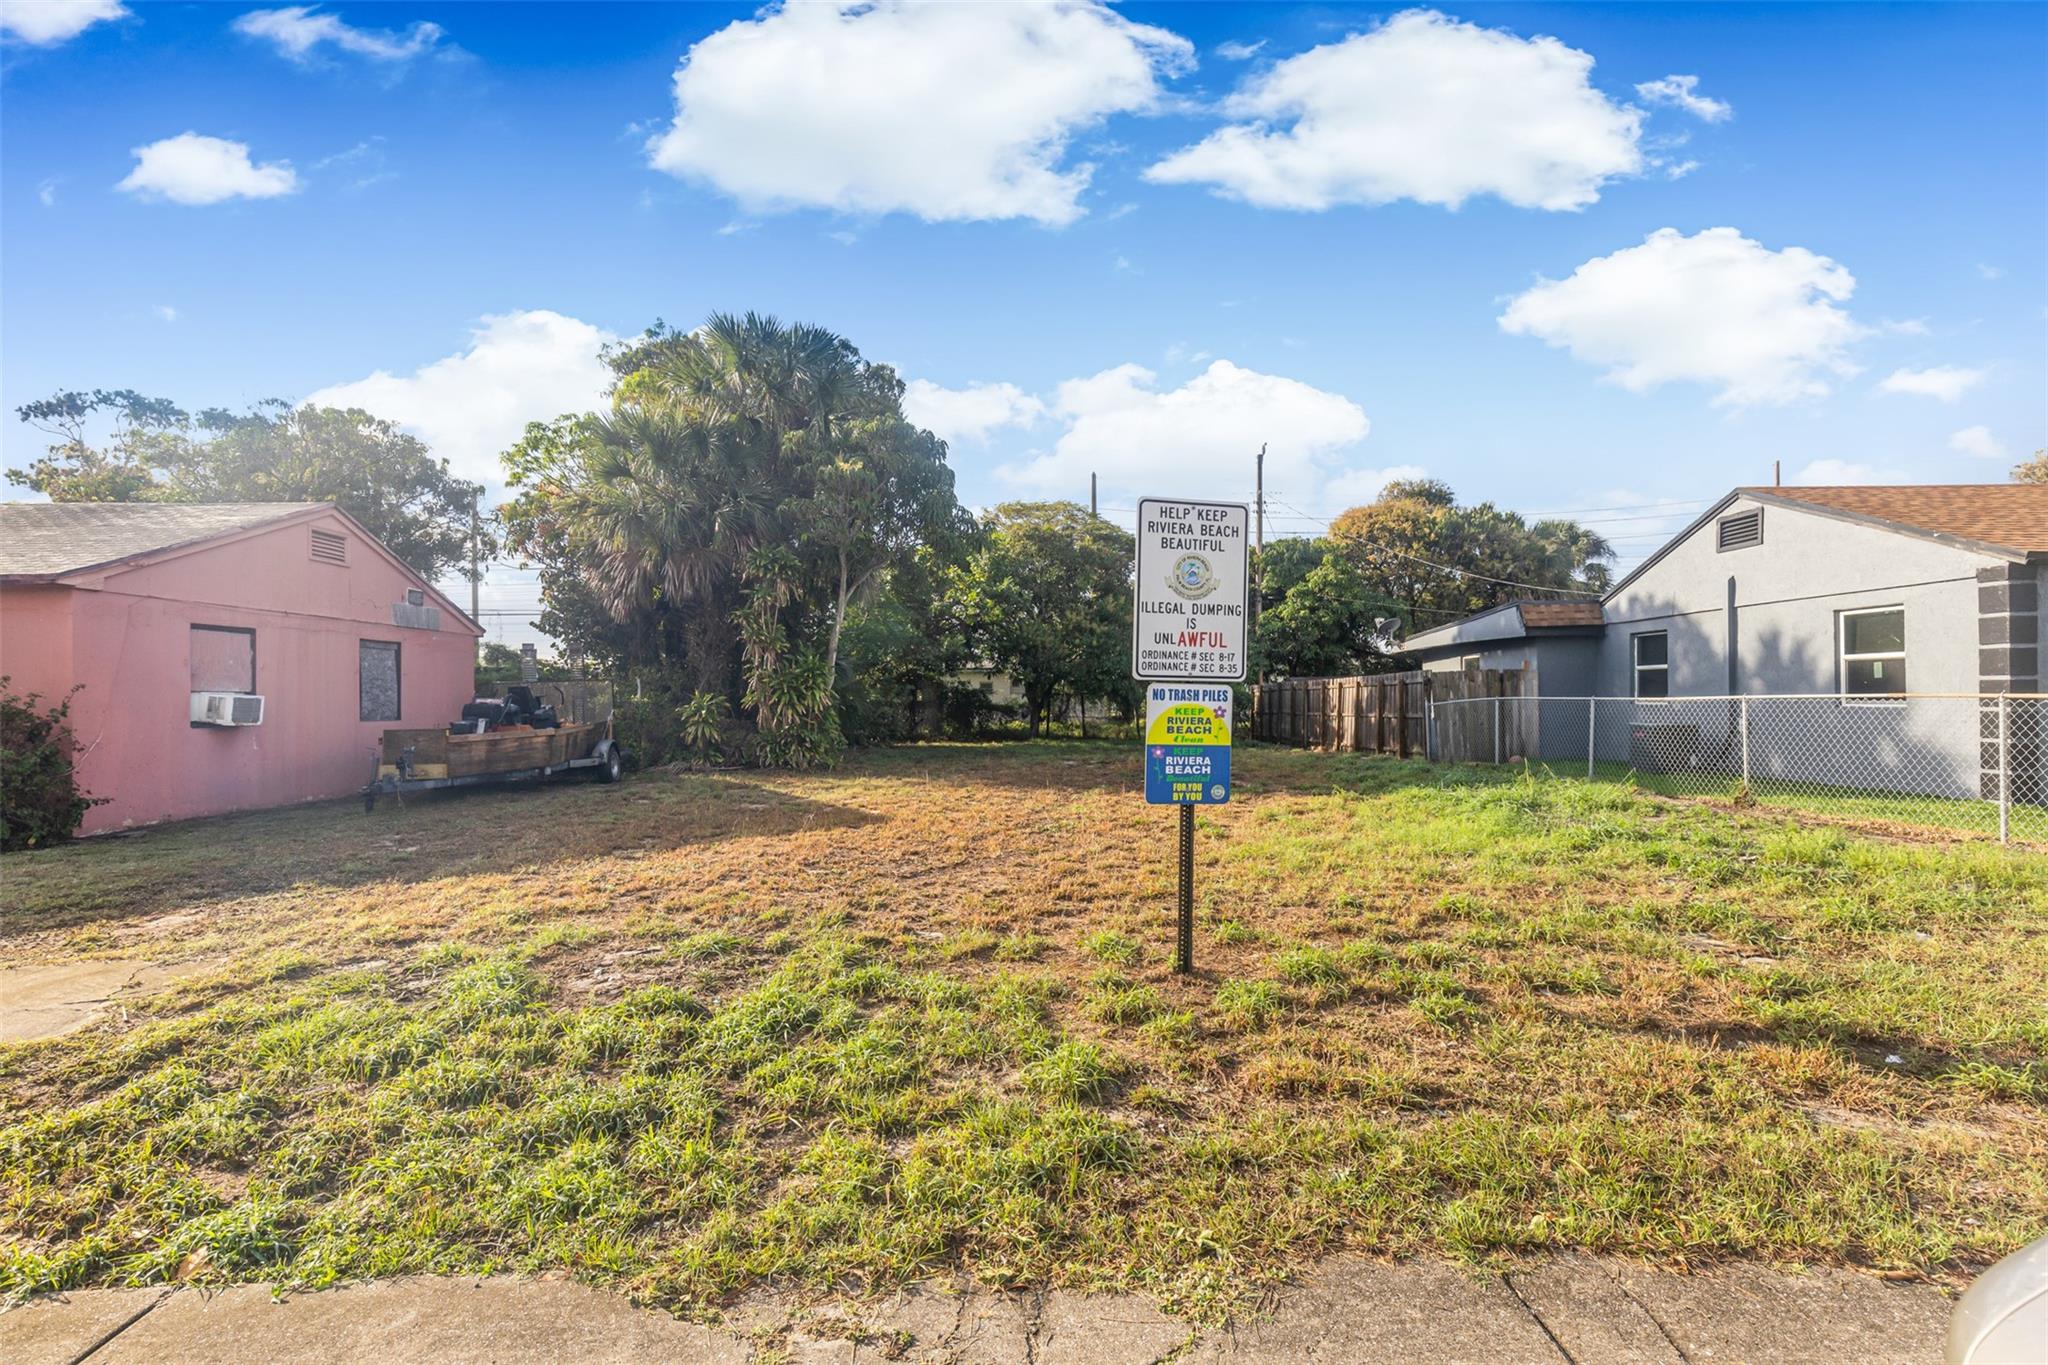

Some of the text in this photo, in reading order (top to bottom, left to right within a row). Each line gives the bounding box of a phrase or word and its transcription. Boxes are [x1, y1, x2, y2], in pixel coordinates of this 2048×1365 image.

[1160, 507, 1228, 522] HELP KEEP
[1148, 521, 1239, 538] RIVIERA BEACH
[1161, 537, 1224, 552] BEAUTIFUL
[1141, 601, 1242, 617] ILLEGAL DUMPING
[1187, 618, 1197, 630] IS
[1154, 632, 1227, 648] UNLAWFUL
[1142, 651, 1235, 662] ORDINANCE # SEC 8-17
[1142, 662, 1237, 673] ORDINANCE # SEC 8-35
[1153, 688, 1228, 702] NO TRASH PILES
[1167, 717, 1212, 725] RIVIERA
[1167, 726, 1212, 734] BEACH
[1166, 757, 1211, 765] RIVIERA
[1166, 766, 1211, 774] BEACH
[1173, 783, 1202, 791] FOR YOU
[1173, 792, 1202, 800] BY YOU
